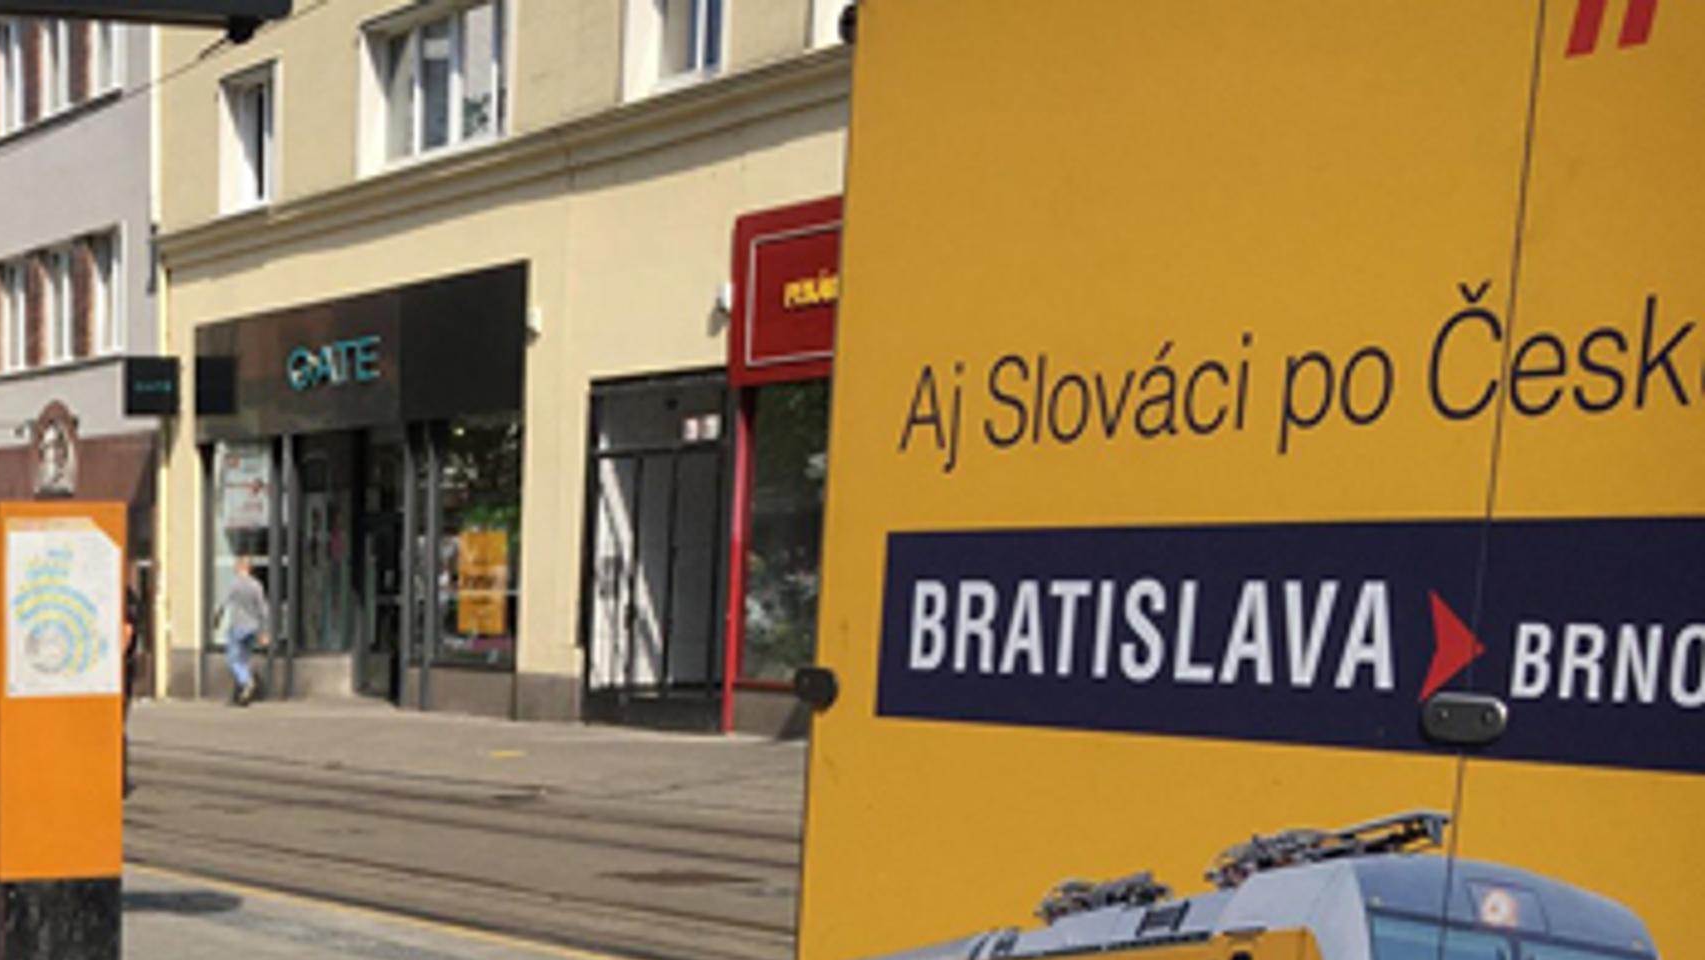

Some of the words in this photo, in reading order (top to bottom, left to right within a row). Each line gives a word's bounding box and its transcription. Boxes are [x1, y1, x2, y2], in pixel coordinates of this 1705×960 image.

[286, 334, 381, 392] GATE
[898, 362, 966, 473] Aj
[983, 333, 1253, 449] Slováci
[1278, 346, 1394, 456] po
[1428, 280, 1705, 421] Česk
[909, 579, 1396, 691] BRATISLAVA
